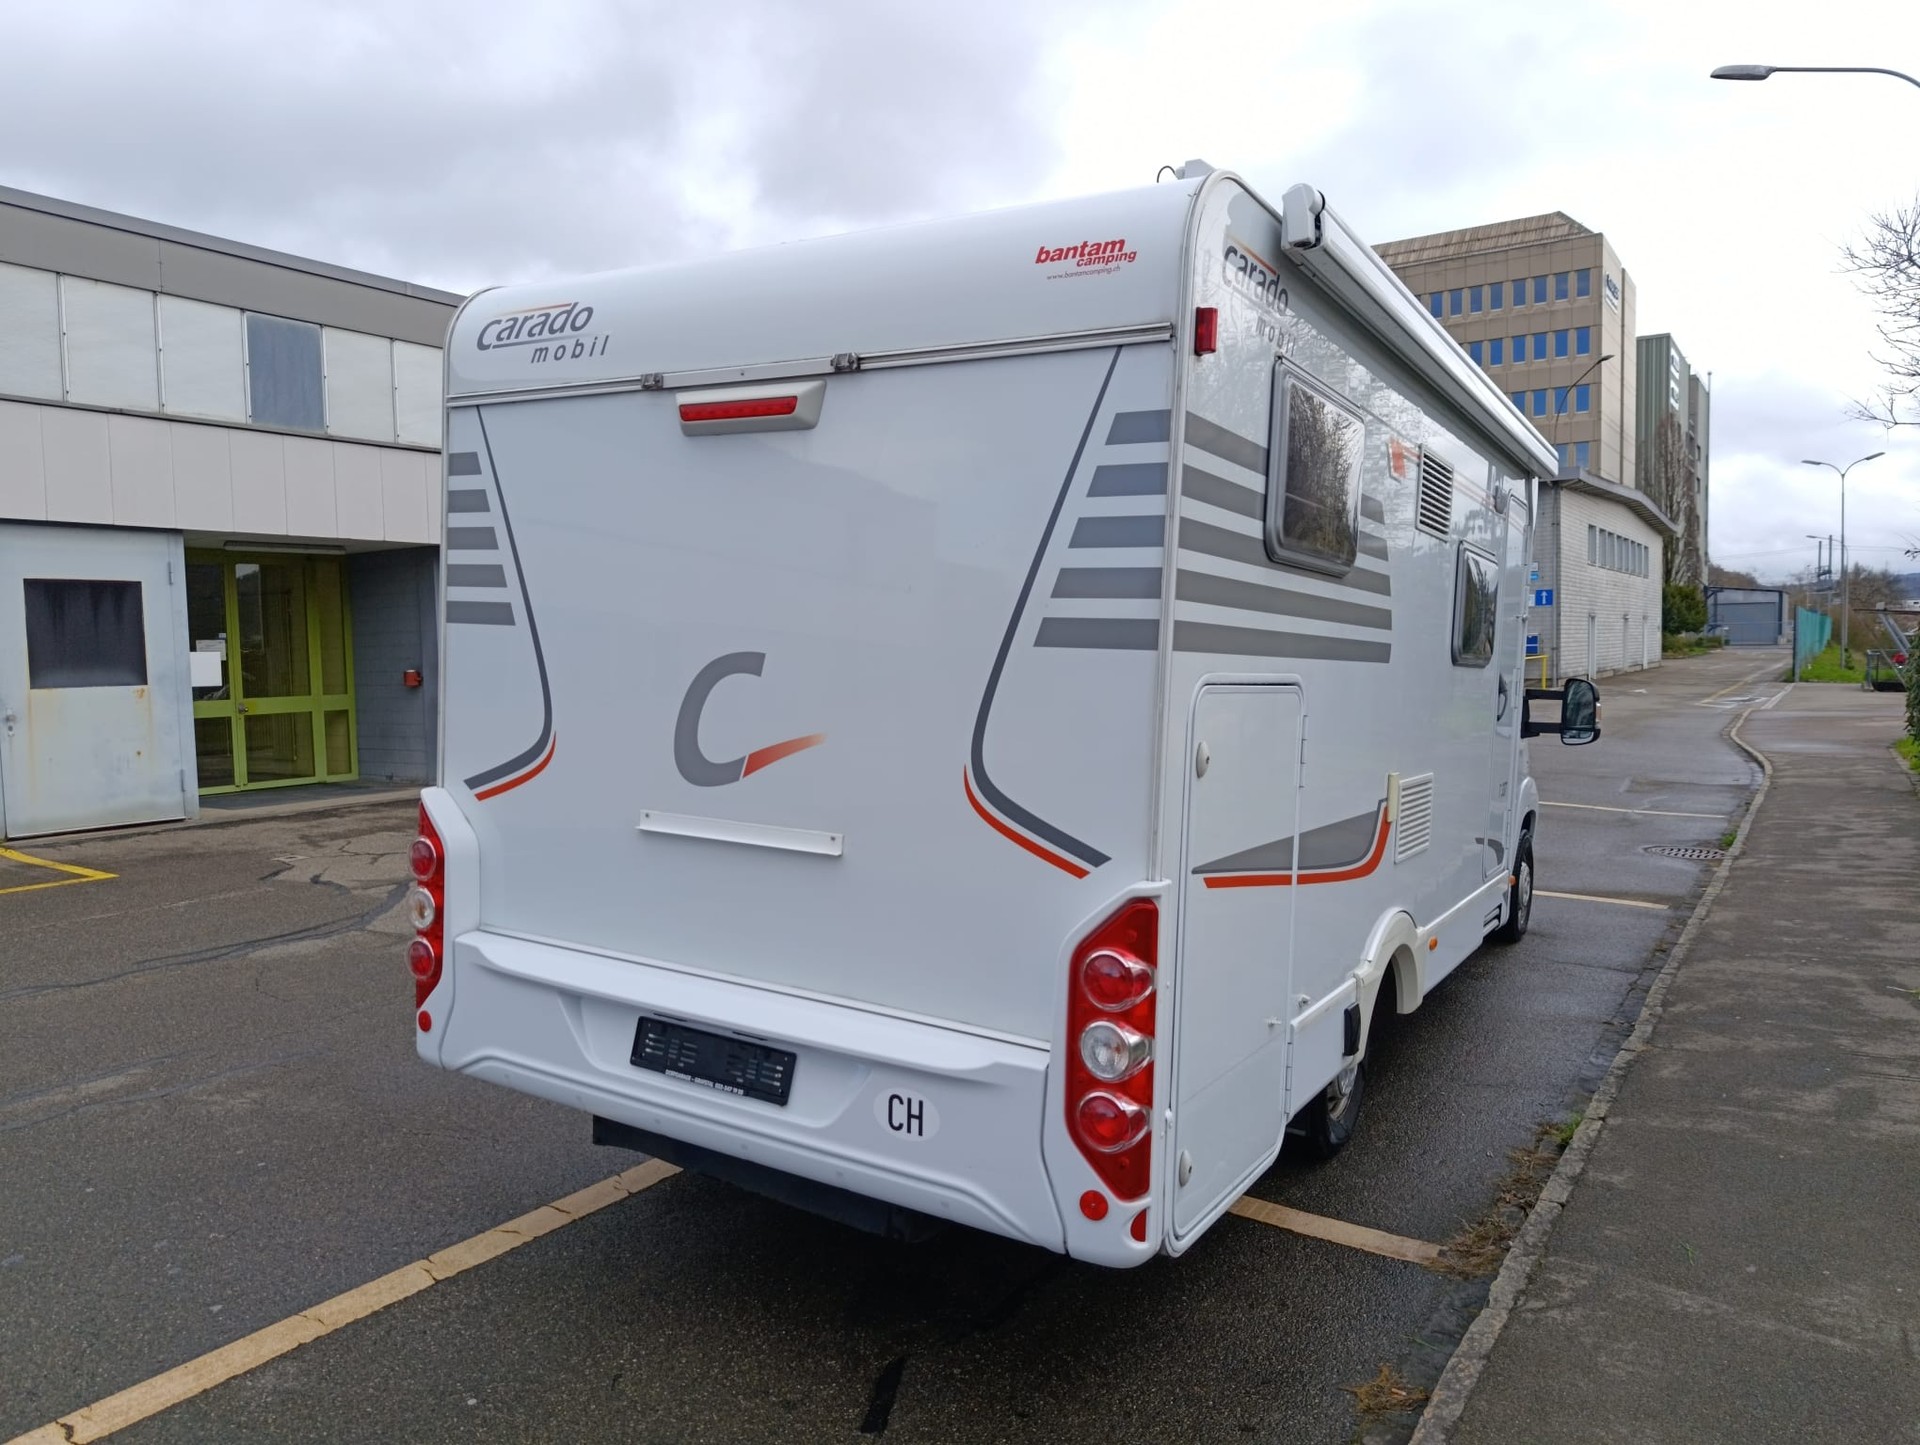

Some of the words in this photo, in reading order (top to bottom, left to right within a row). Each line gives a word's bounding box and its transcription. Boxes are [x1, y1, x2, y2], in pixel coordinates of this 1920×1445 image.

[1035, 239, 1126, 264] bantam
[1076, 251, 1137, 267] camping
[531, 334, 610, 364] mobil
[888, 1093, 924, 1137] CH
